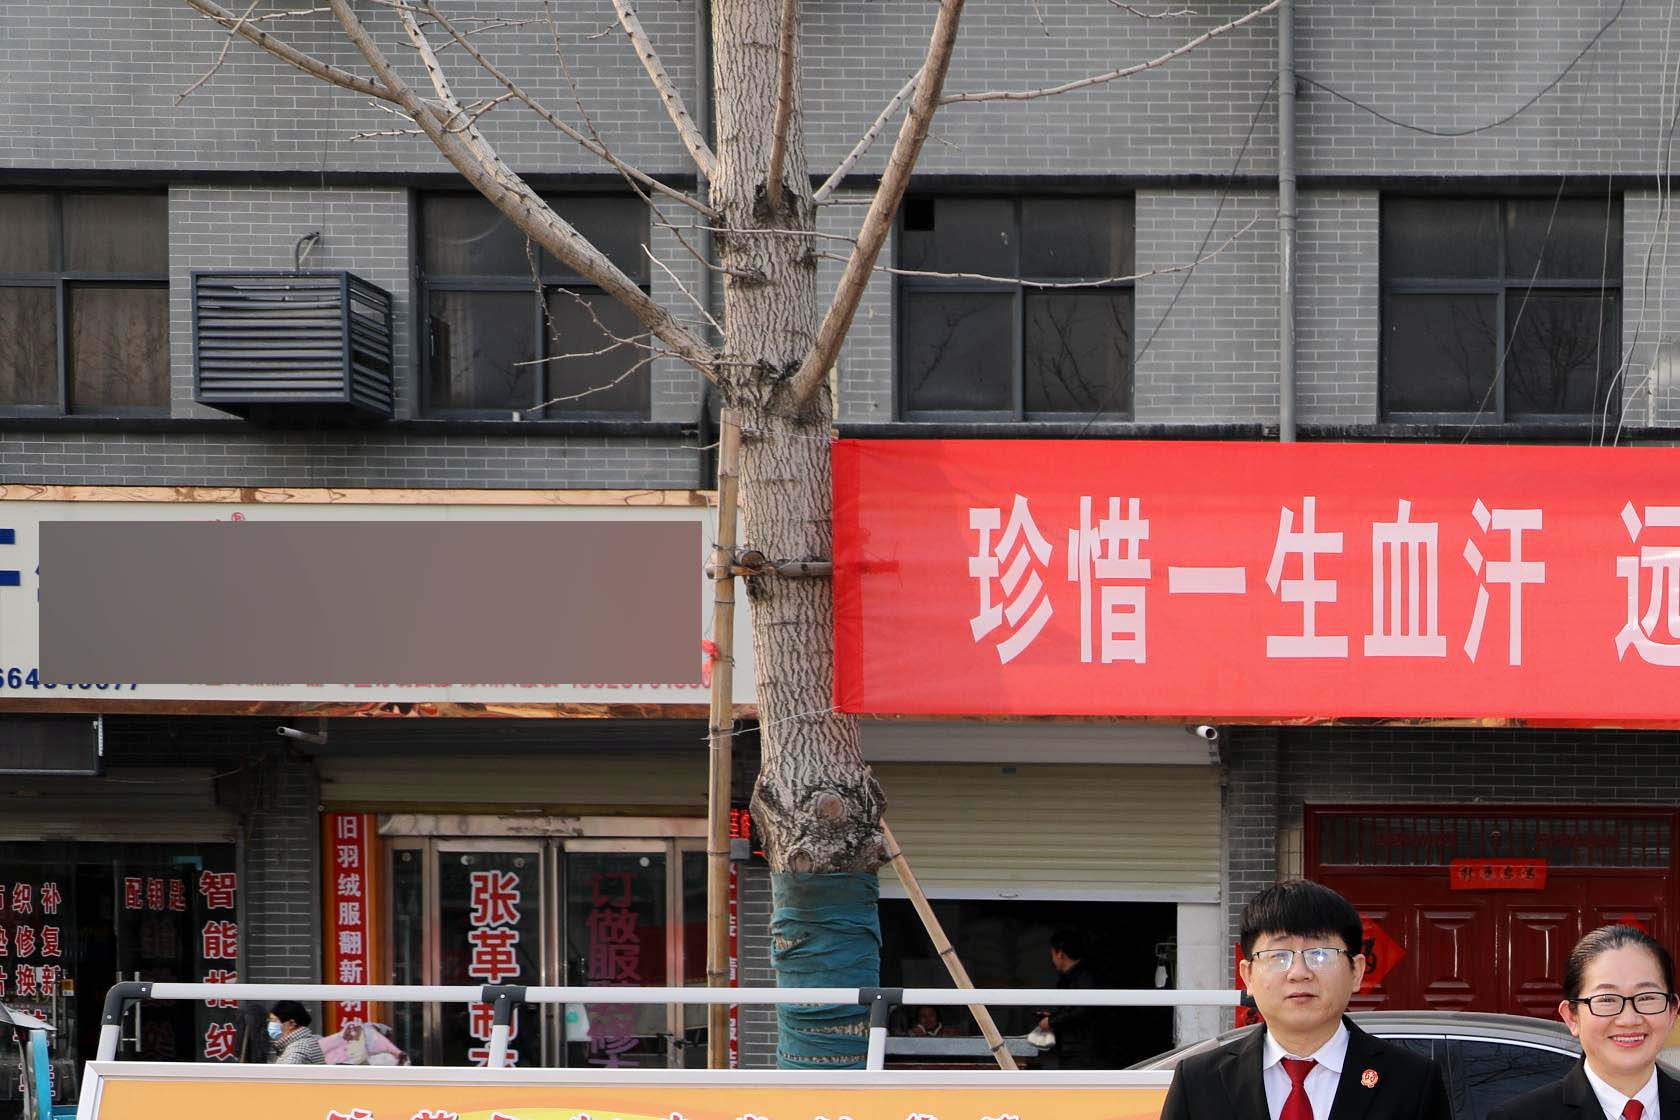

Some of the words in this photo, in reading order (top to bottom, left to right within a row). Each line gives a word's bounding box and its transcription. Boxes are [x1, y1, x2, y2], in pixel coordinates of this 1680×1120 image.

[968, 493, 1546, 666] 珍惜一生血汗
[0, 882, 62, 914] 织补
[124, 876, 188, 912] 配钥匙
[200, 870, 239, 1061] 智能指纹
